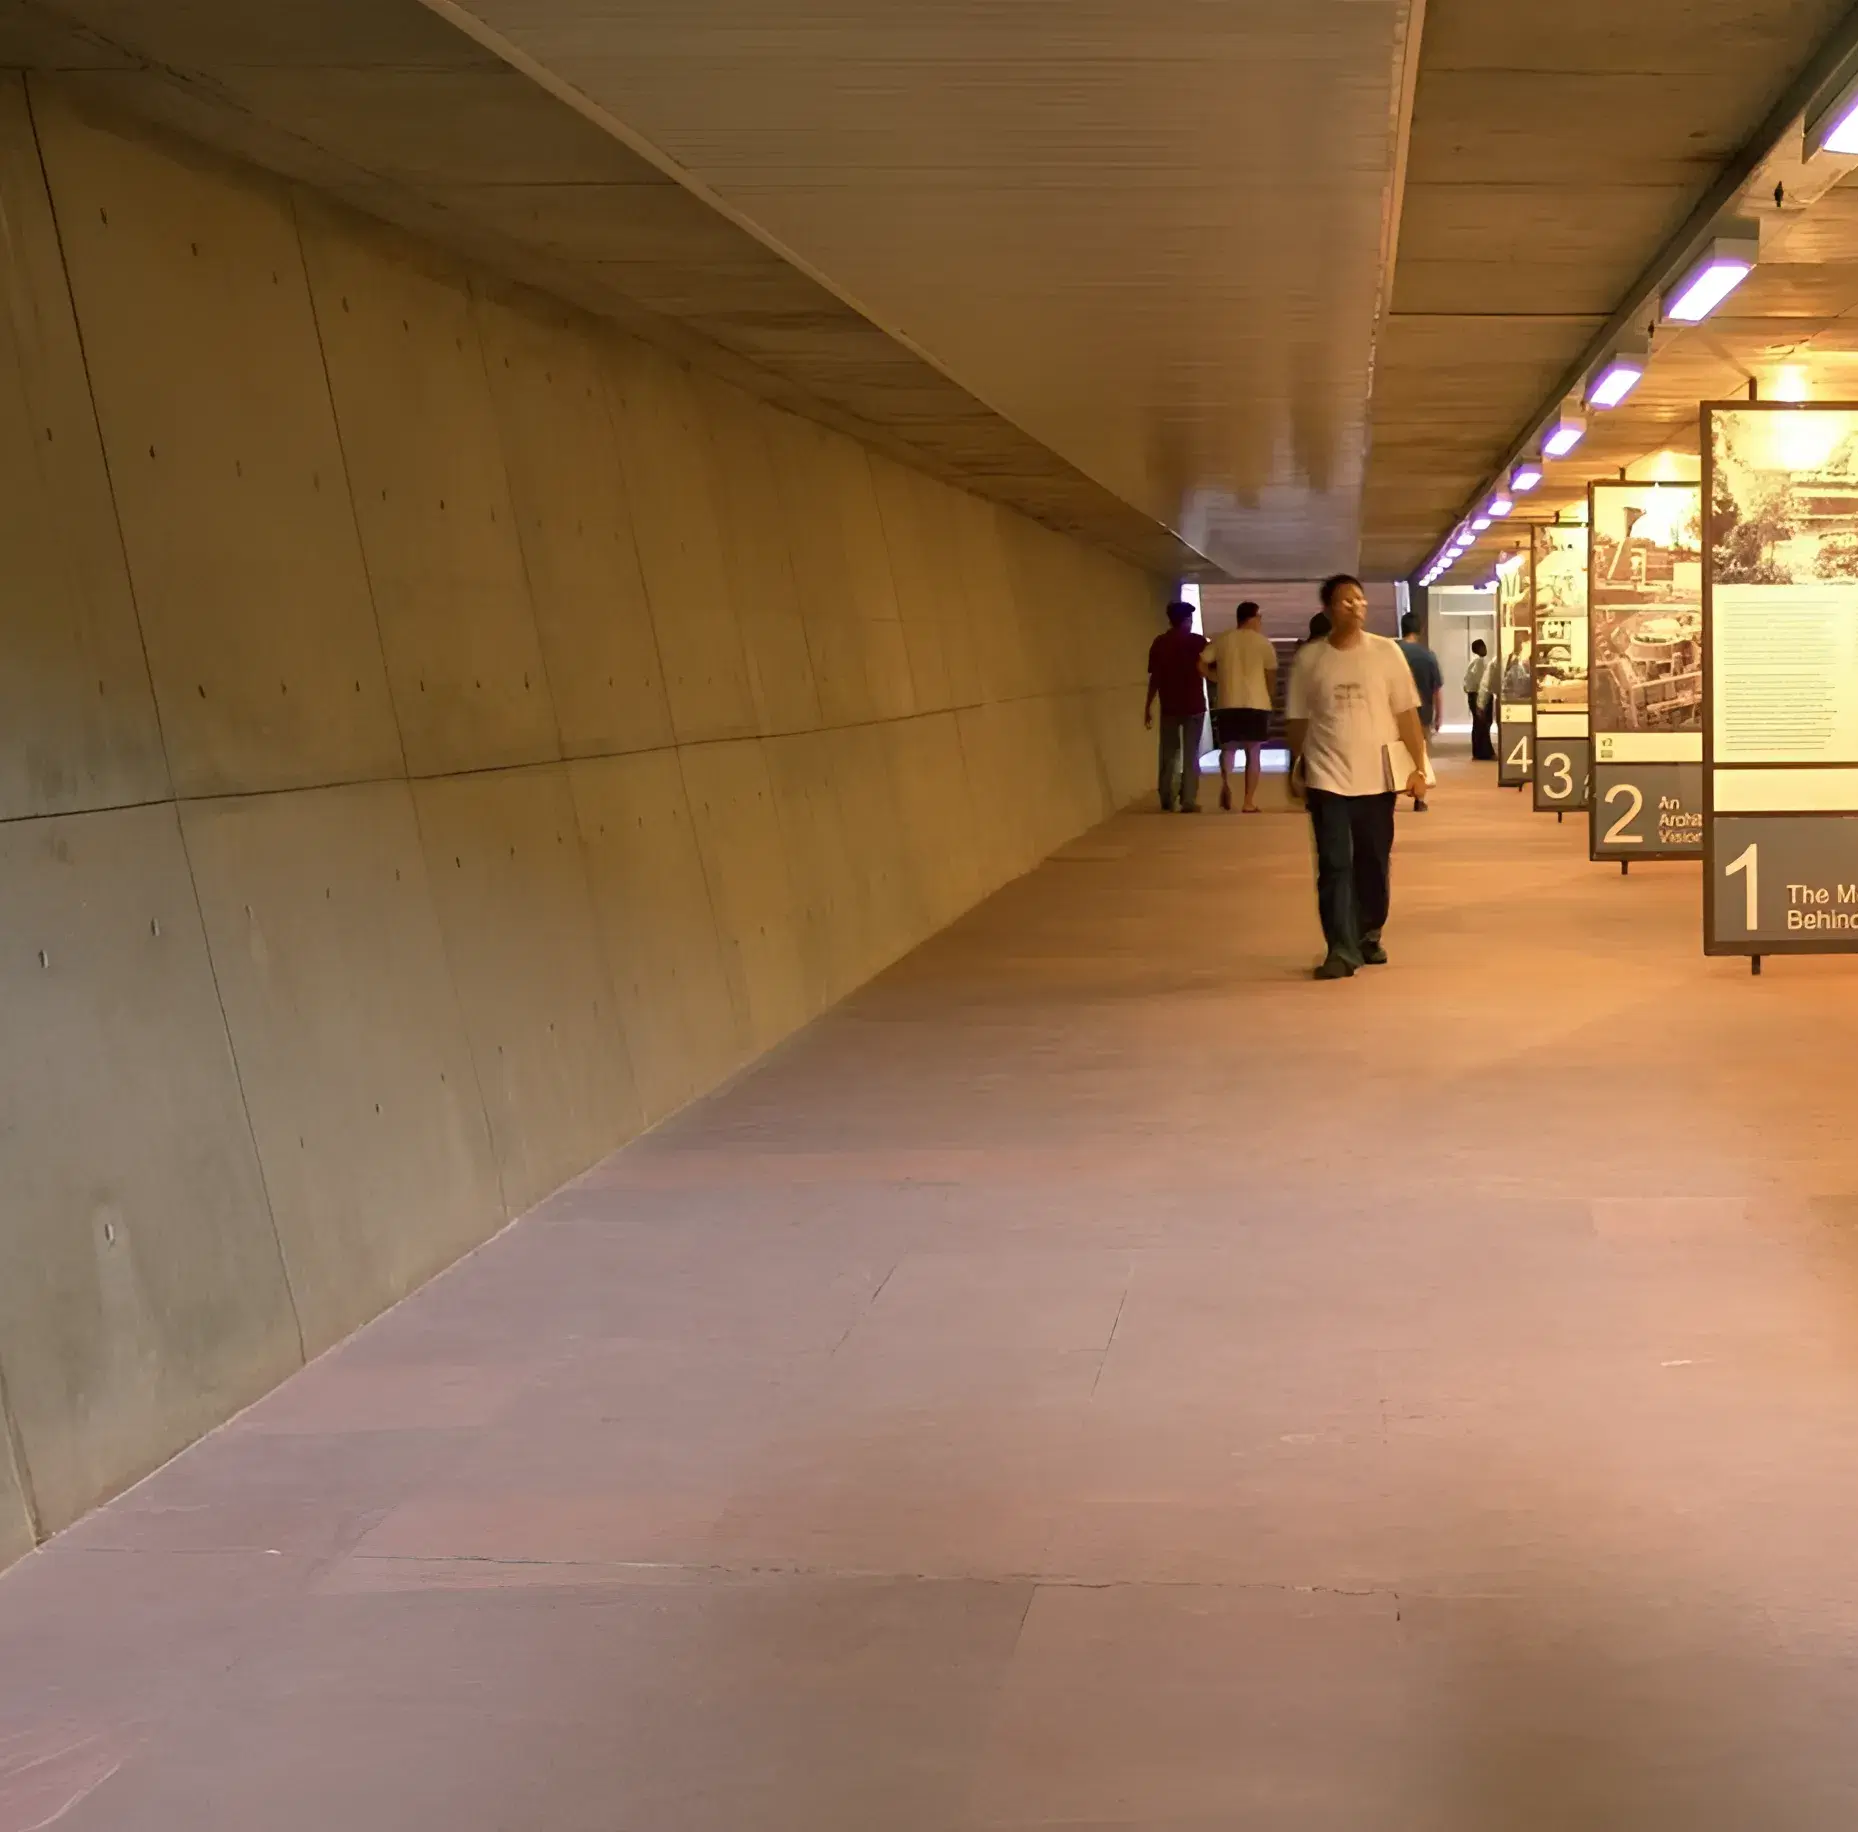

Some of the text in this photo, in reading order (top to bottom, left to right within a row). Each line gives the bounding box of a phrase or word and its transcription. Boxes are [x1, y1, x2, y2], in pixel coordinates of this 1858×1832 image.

[1506, 735, 1533, 773] 4
[1543, 752, 1573, 799] 3
[1603, 783, 1644, 843] 2
[1658, 796, 1680, 810] An
[1725, 843, 1758, 930] 1
[1786, 884, 1830, 905] The
